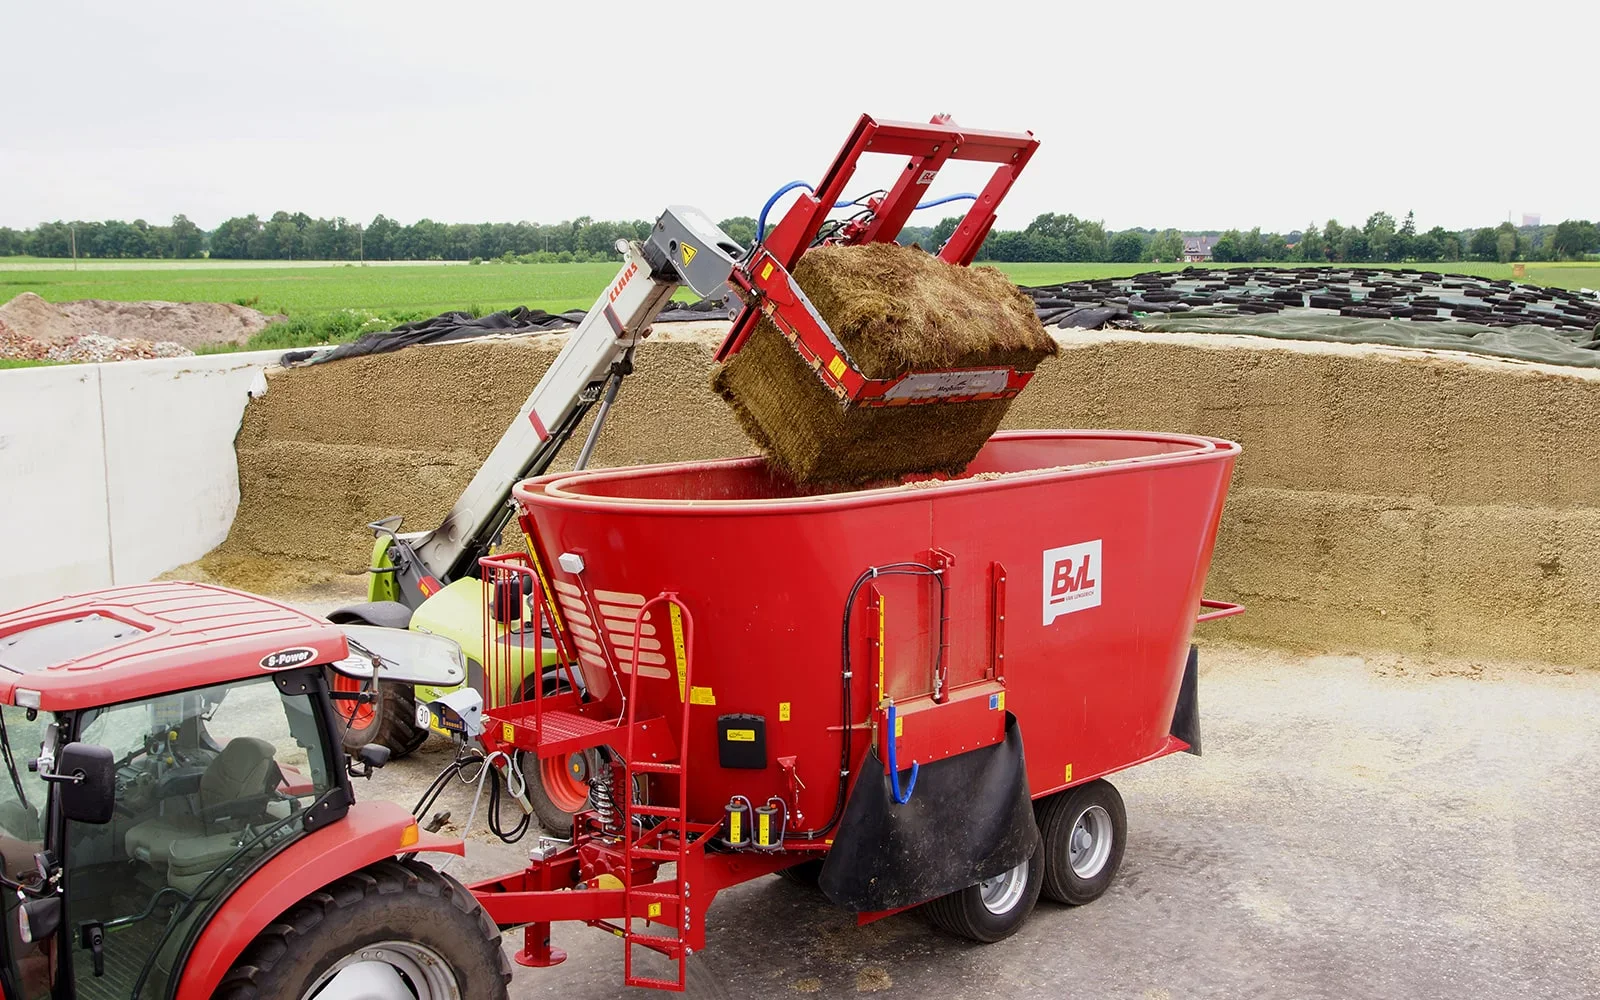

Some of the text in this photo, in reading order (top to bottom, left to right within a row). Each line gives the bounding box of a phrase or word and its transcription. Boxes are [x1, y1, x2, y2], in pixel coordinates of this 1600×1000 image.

[609, 261, 638, 303] CLAAS
[268, 651, 309, 667] S-Power
[419, 708, 429, 724] 30
